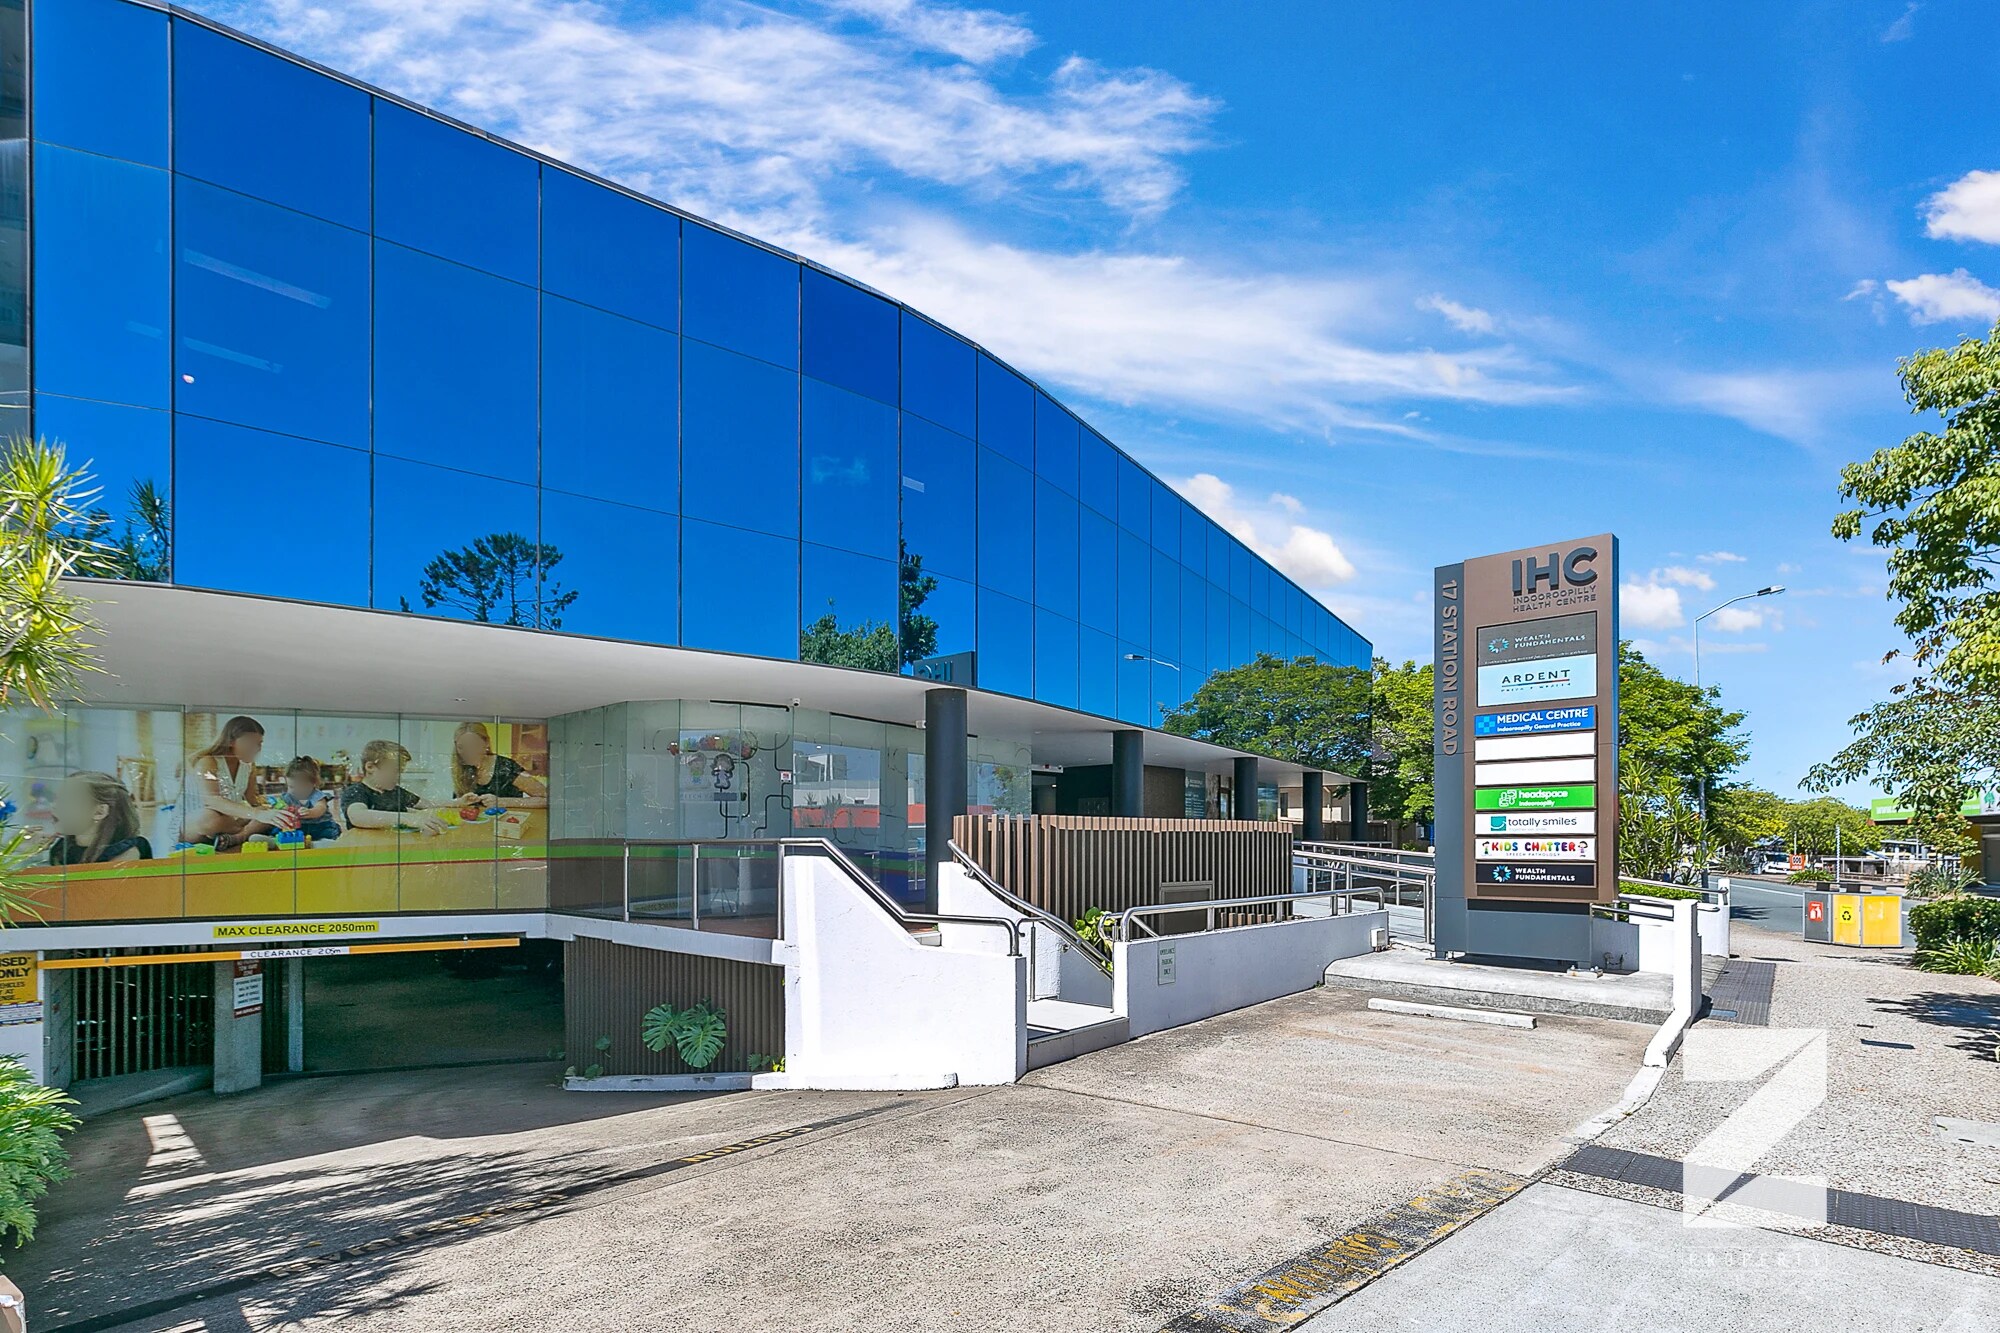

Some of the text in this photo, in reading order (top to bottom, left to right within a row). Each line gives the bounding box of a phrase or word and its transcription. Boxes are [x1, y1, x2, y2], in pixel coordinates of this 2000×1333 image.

[1512, 546, 1598, 596] IHC
[1513, 585, 1596, 604] INDOOROOPILLY
[1513, 594, 1597, 613] HEALTH CENTRE
[1514, 633, 1551, 642] WEALTH
[1514, 634, 1586, 649] FUNDAMENTALS
[1442, 579, 1458, 756] 17 STATION ROAD
[1501, 669, 1571, 684] ARDENT
[1497, 708, 1588, 724] MEDICAL CENTRE
[1518, 789, 1569, 800] headspace
[1508, 817, 1577, 827] totally smiles
[1491, 841, 1576, 852] KIDS CHATTER
[1515, 874, 1576, 882] FUNDAMENTALS
[217, 923, 376, 936] MAX CLEARANCE 2050mm
[250, 949, 312, 958] CLEARANCE
